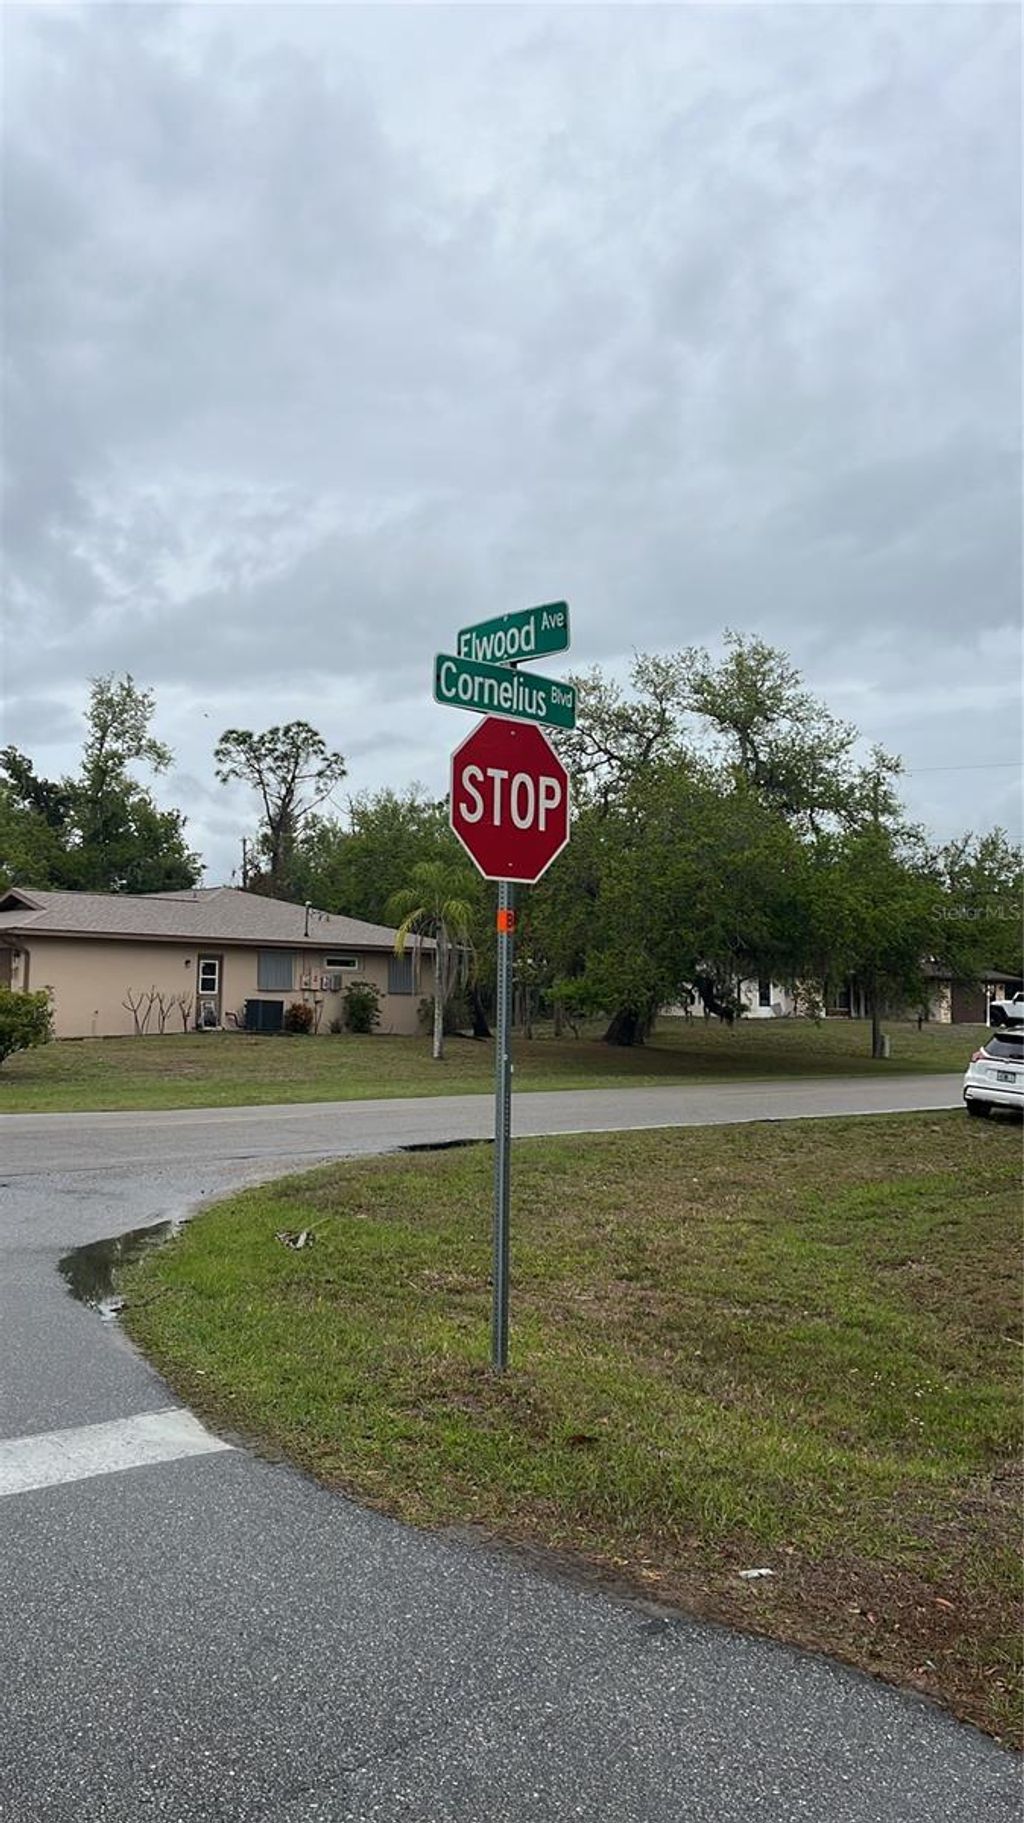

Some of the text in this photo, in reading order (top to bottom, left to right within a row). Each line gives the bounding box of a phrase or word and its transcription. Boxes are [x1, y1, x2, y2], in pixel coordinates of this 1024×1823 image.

[460, 611, 564, 661] Elwood Ave
[440, 661, 573, 717] Cornelius Blvd
[459, 764, 562, 832] STOP
